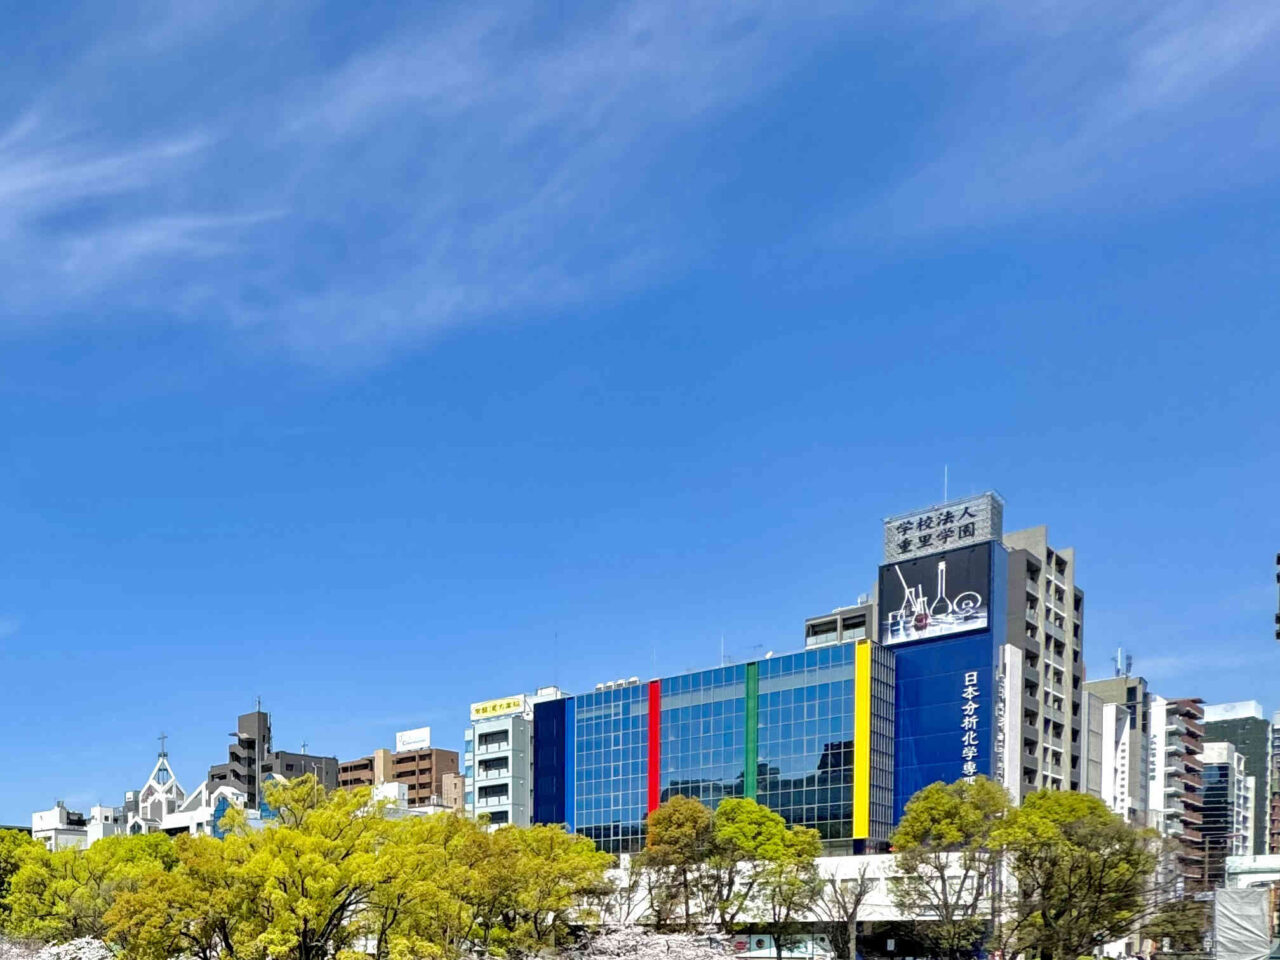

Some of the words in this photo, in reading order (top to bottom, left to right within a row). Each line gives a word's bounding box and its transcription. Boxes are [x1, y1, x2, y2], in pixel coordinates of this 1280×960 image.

[896, 506, 977, 536] 学校法人
[896, 521, 976, 555] 重里学園
